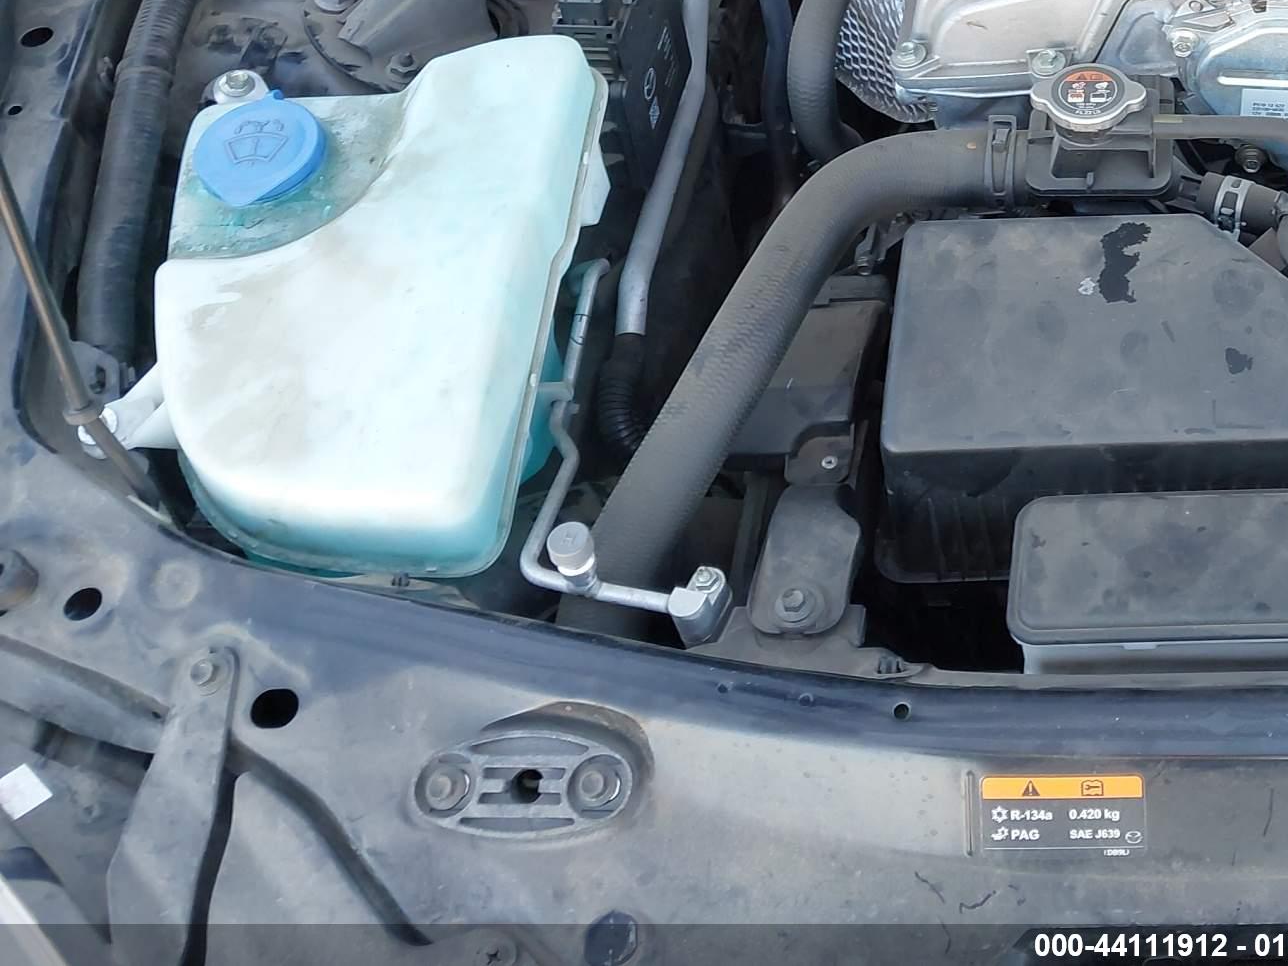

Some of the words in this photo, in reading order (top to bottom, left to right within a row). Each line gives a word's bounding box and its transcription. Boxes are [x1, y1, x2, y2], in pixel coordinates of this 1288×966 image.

[1010, 809, 1053, 821] R-134a
[1069, 809, 1101, 820] 0.420
[1104, 808, 1121, 822] kg
[1010, 829, 1040, 840] PAG
[1069, 829, 1093, 840] SAE
[1095, 829, 1121, 839] J639
